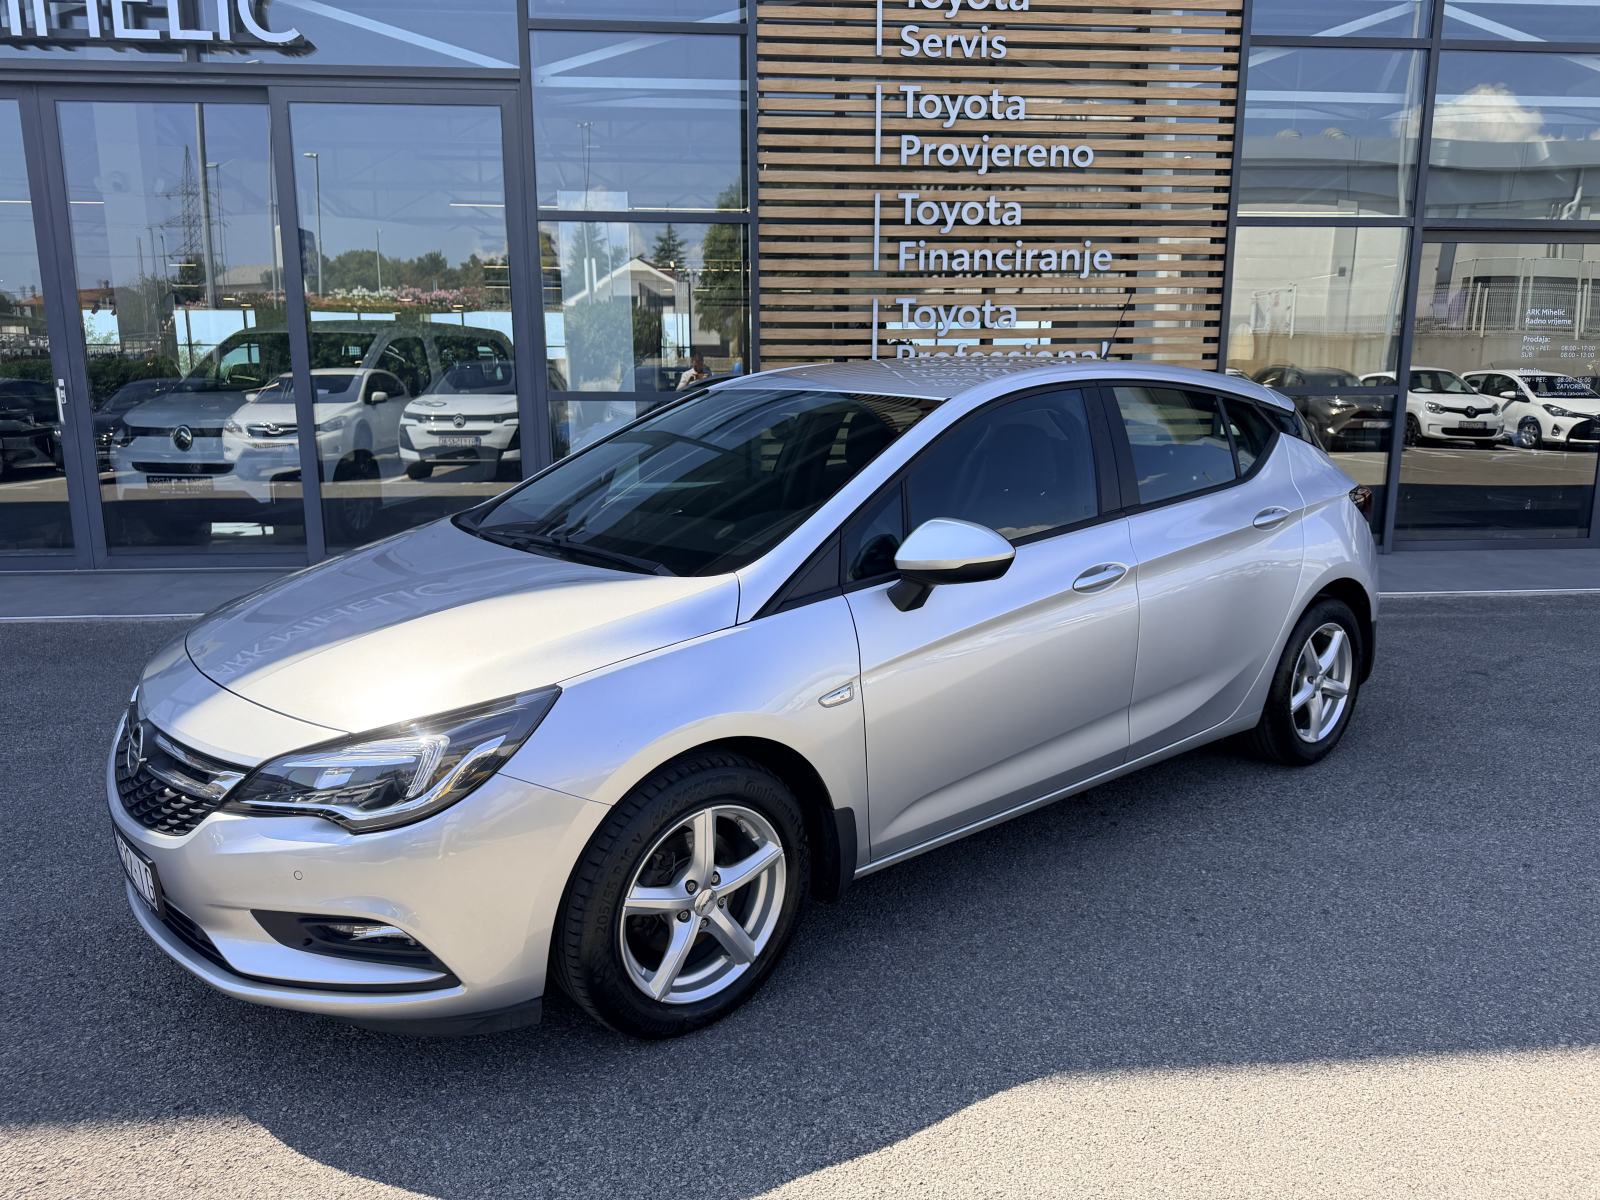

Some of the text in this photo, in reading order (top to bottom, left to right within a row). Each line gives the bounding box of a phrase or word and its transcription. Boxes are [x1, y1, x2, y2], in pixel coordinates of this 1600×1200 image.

[900, 25, 1007, 59] Servis
[899, 85, 1026, 128] Toyota
[900, 135, 1095, 175] Provjereno
[898, 192, 1022, 234] Toyota
[899, 240, 1113, 278] Financiranje
[895, 297, 1017, 337] Toyota
[1526, 308, 1541, 316] ARK
[1547, 318, 1572, 326] vrijeme
